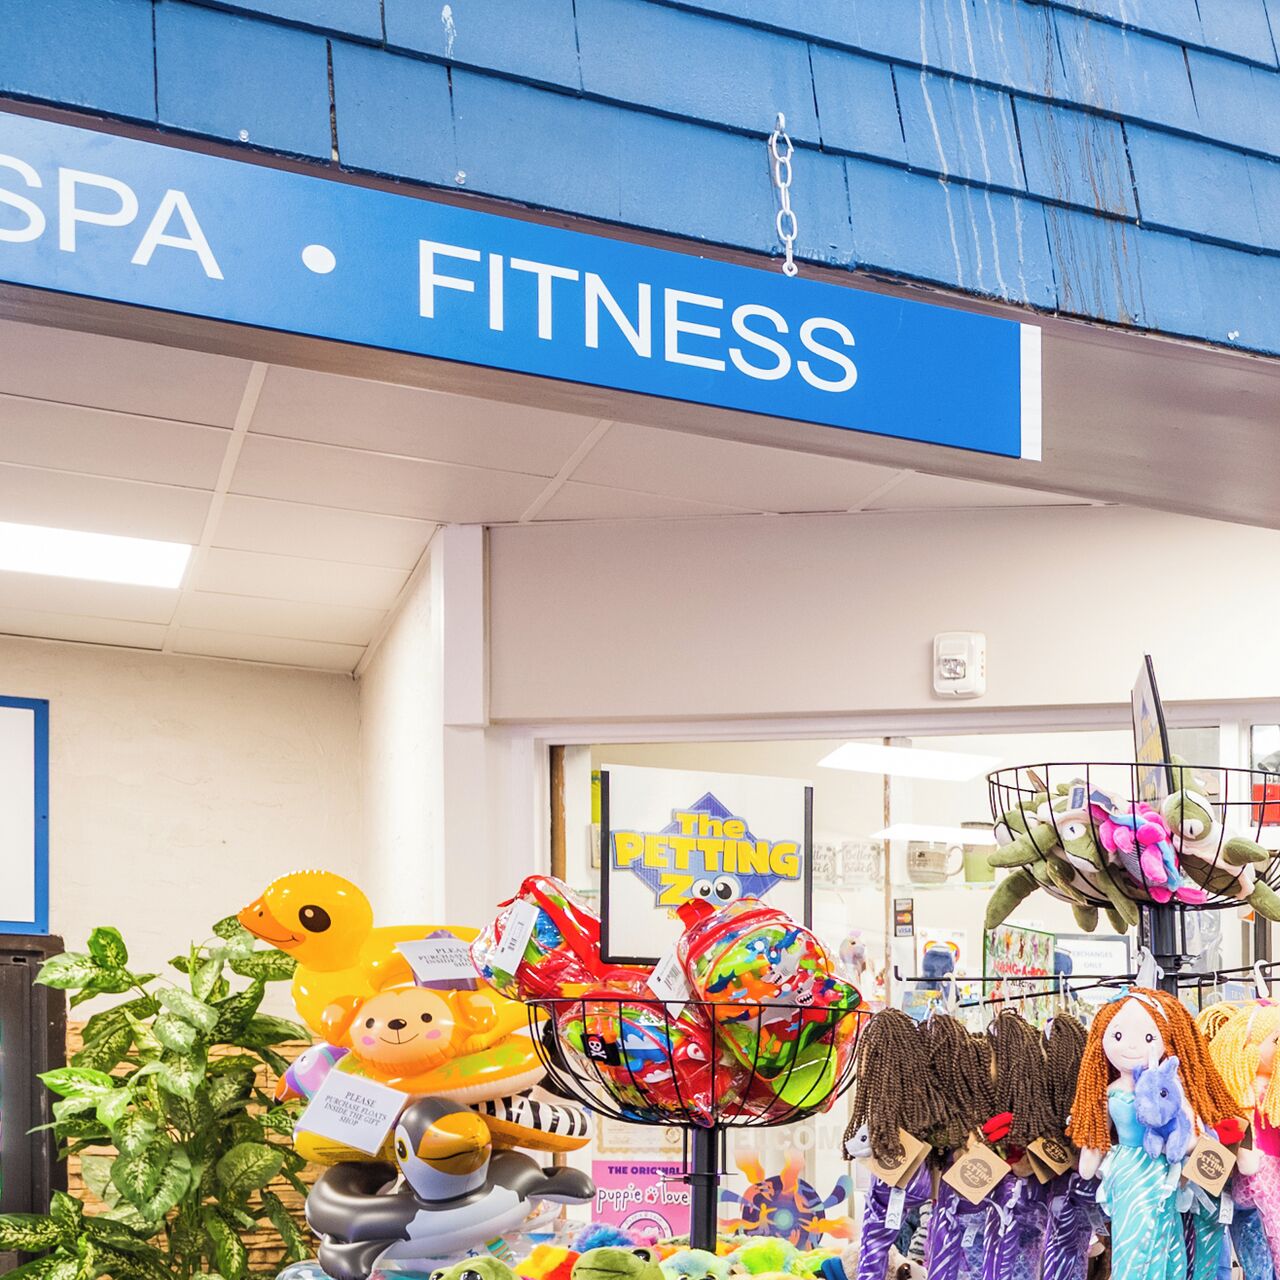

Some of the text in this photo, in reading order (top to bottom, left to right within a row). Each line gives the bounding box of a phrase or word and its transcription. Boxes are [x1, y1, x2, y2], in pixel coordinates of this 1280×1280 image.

[0, 153, 860, 394] SPA FITNESS
[675, 812, 745, 839] The
[613, 831, 800, 878] PETTING
[325, 1094, 387, 1121] PURCHASE FLOATS
[345, 1091, 376, 1107] PLEASE
[324, 1102, 381, 1126] INSIDE THE GIFT
[339, 1115, 359, 1127] SHOP
[607, 1165, 631, 1175] THE
[596, 1183, 690, 1213] puppie love
